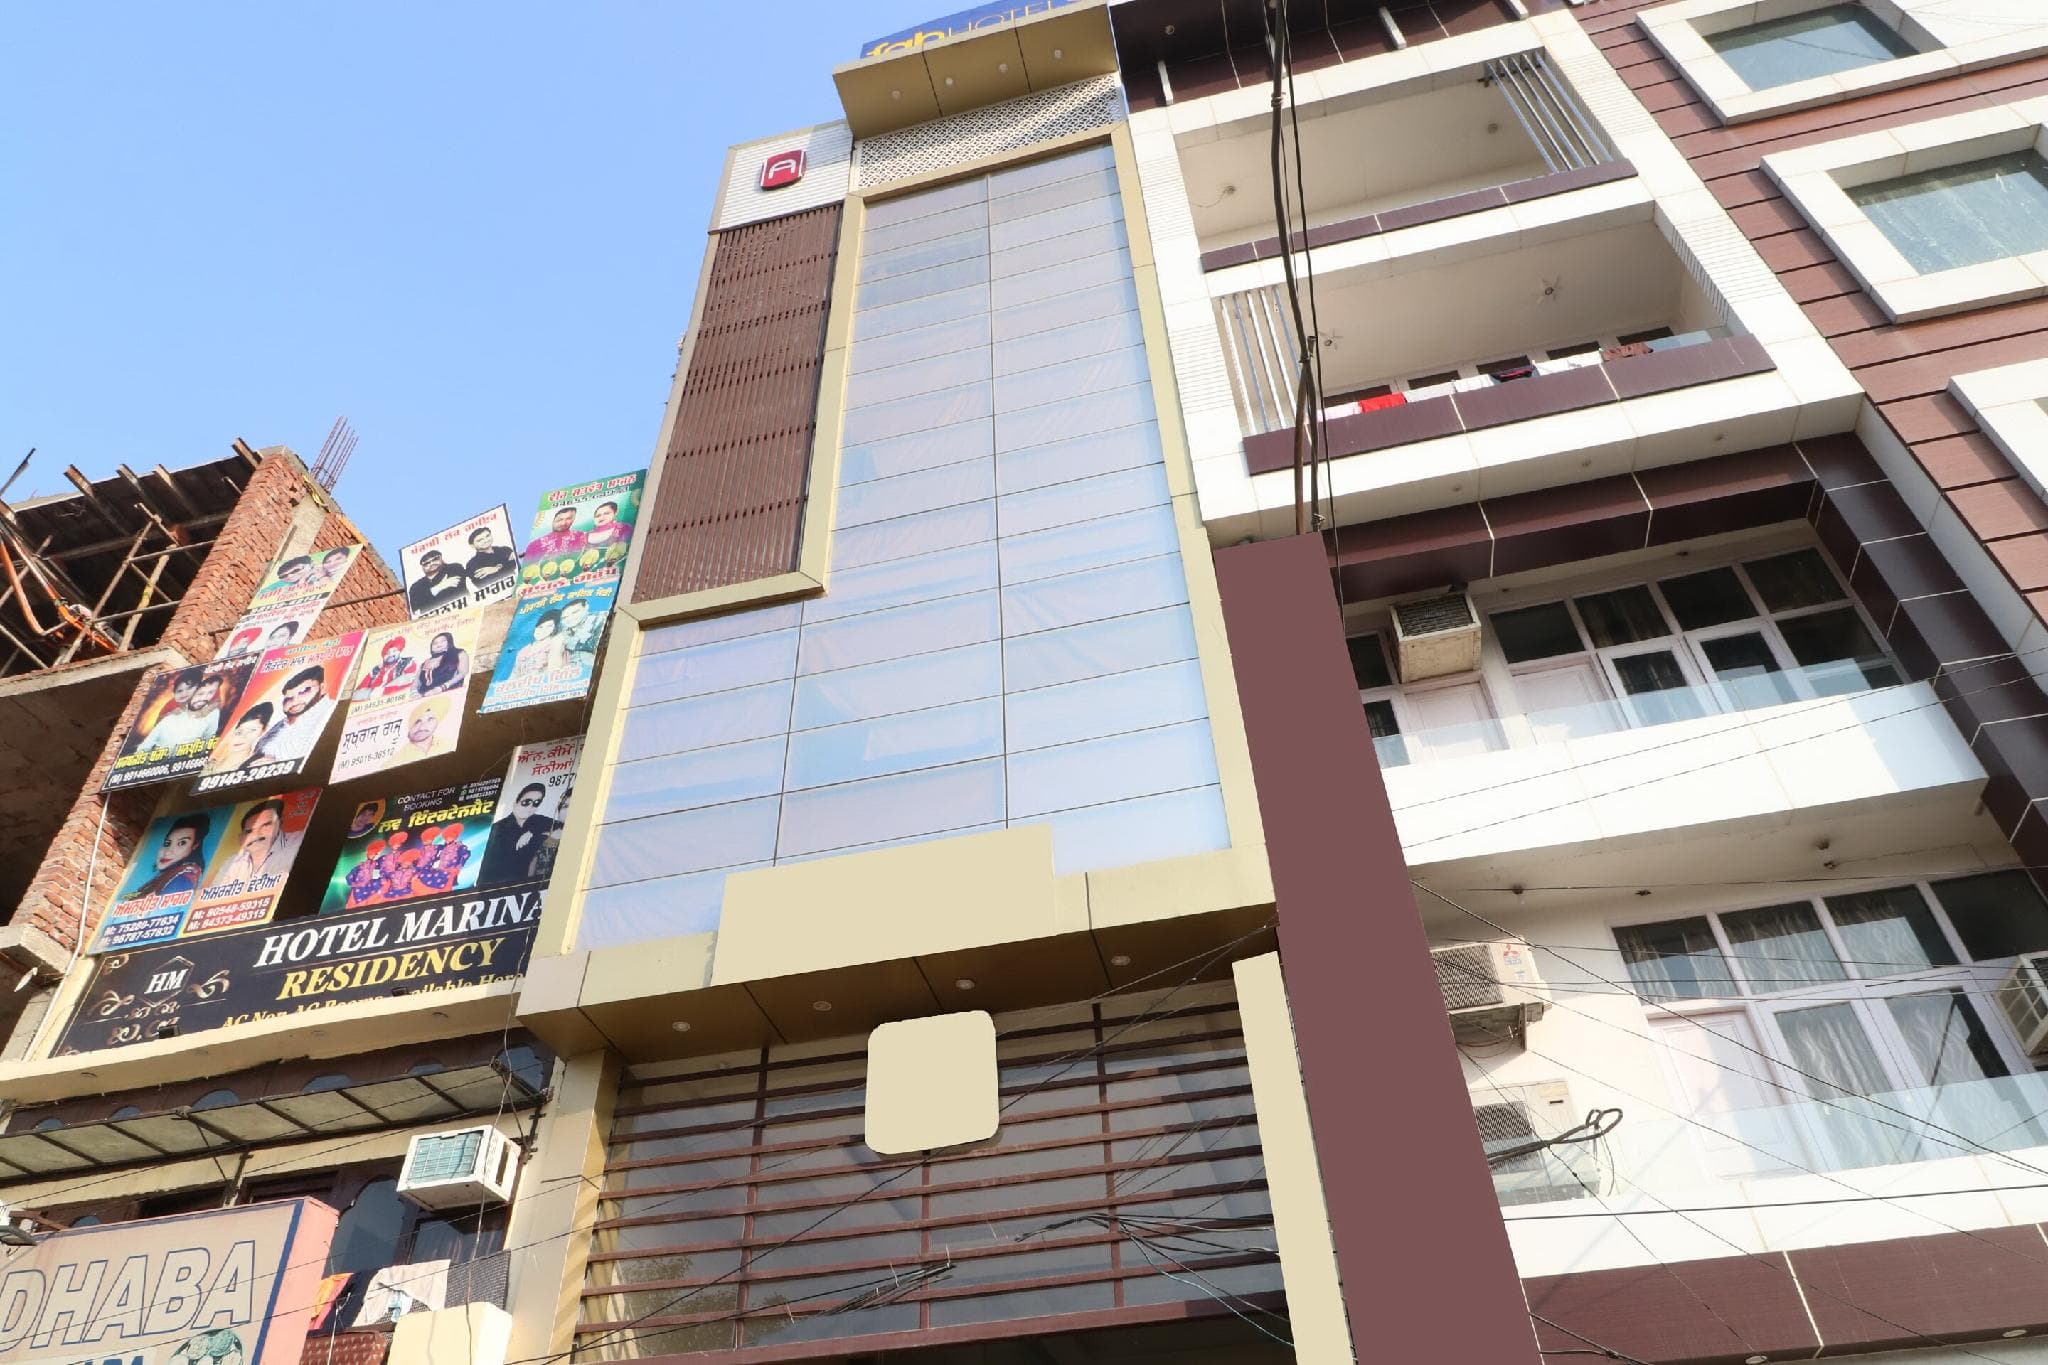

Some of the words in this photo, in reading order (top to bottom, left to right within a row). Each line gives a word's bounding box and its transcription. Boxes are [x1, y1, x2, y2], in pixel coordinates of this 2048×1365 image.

[474, 576, 516, 602] ਸਾਗਰ
[198, 760, 296, 792] 99143-28239
[549, 772, 577, 788] 9877
[398, 791, 438, 805] CONTACT
[438, 786, 457, 797] FOR
[404, 798, 443, 812] BOOKING
[253, 916, 388, 968] HOTEL
[276, 937, 505, 1000] RESIDENCY
[144, 969, 188, 995] HM
[223, 1015, 249, 1028] AC
[0, 1240, 255, 1352] DHABA
